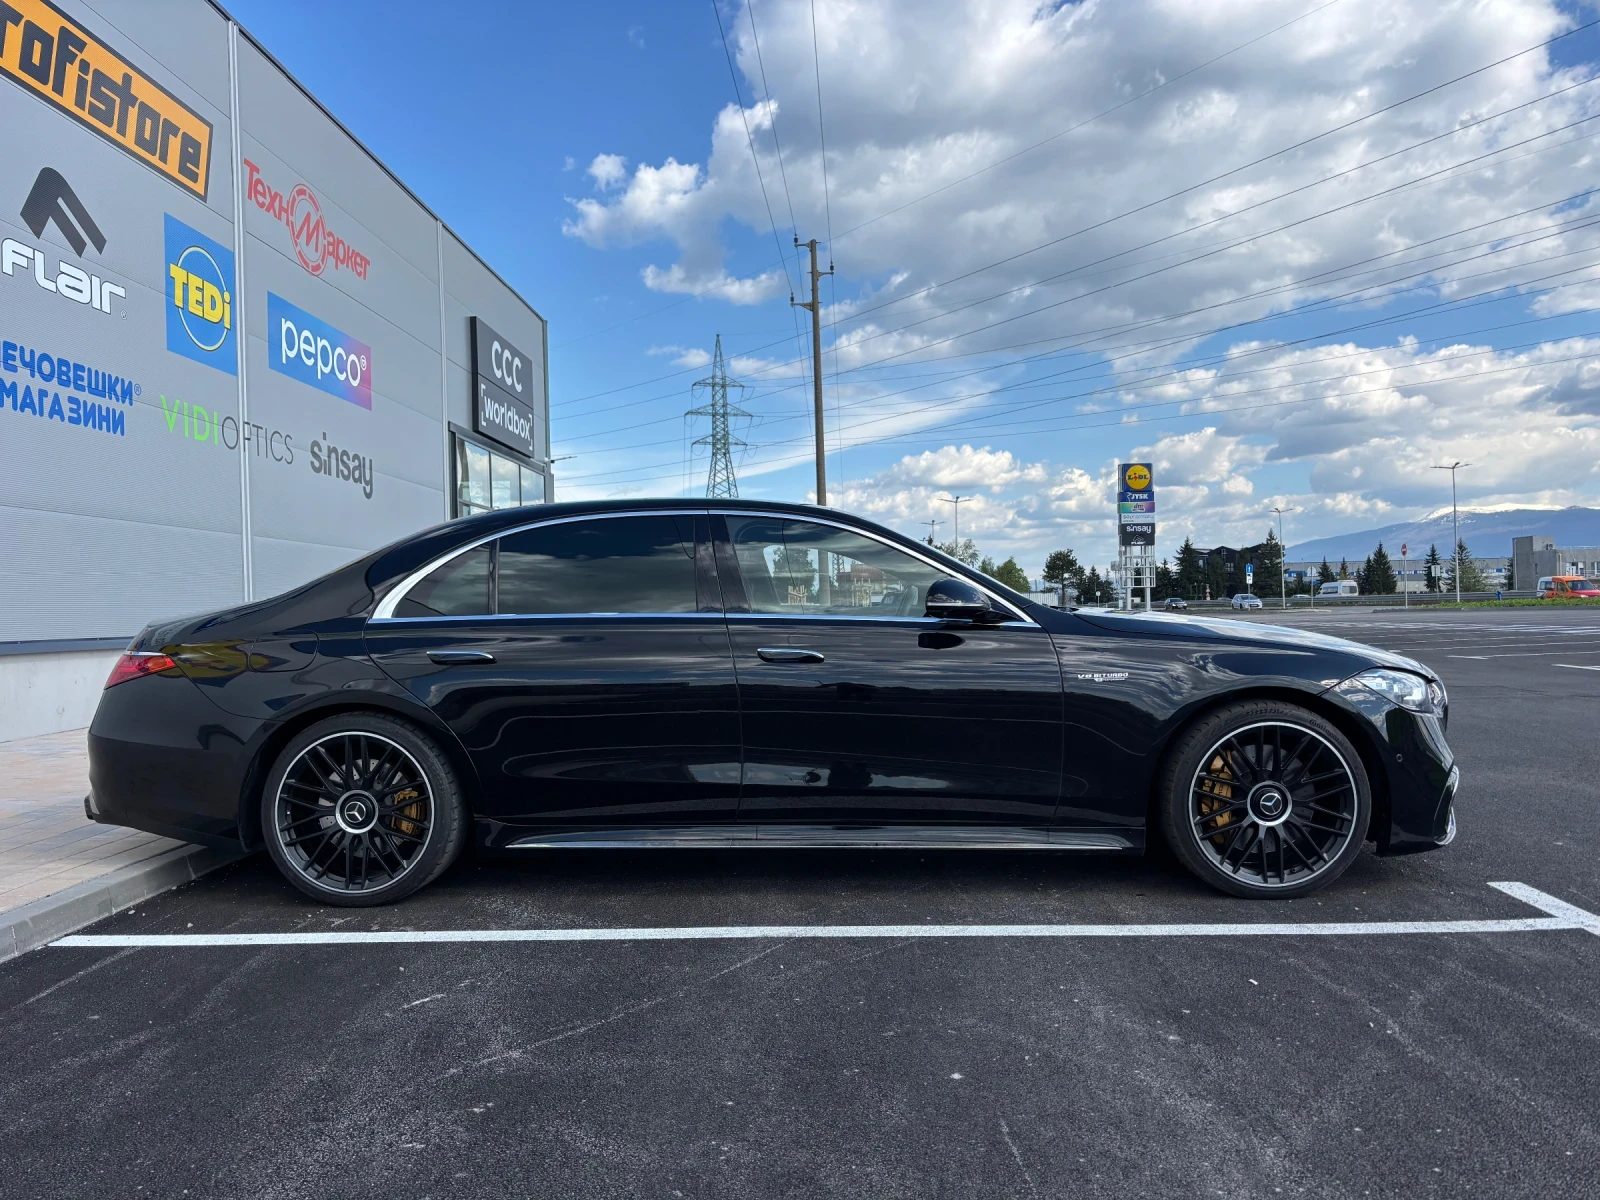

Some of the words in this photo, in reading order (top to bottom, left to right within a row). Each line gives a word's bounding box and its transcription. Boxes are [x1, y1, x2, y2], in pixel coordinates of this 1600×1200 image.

[169, 262, 231, 330] TEDi
[0, 340, 133, 407] ЕЧОВЕШКИ
[491, 340, 522, 393] CCC
[0, 377, 125, 437] МАГАЗИНИ
[484, 395, 531, 441] worldbox
[310, 431, 373, 500] sinsay
[1127, 524, 1151, 533] sinsay
